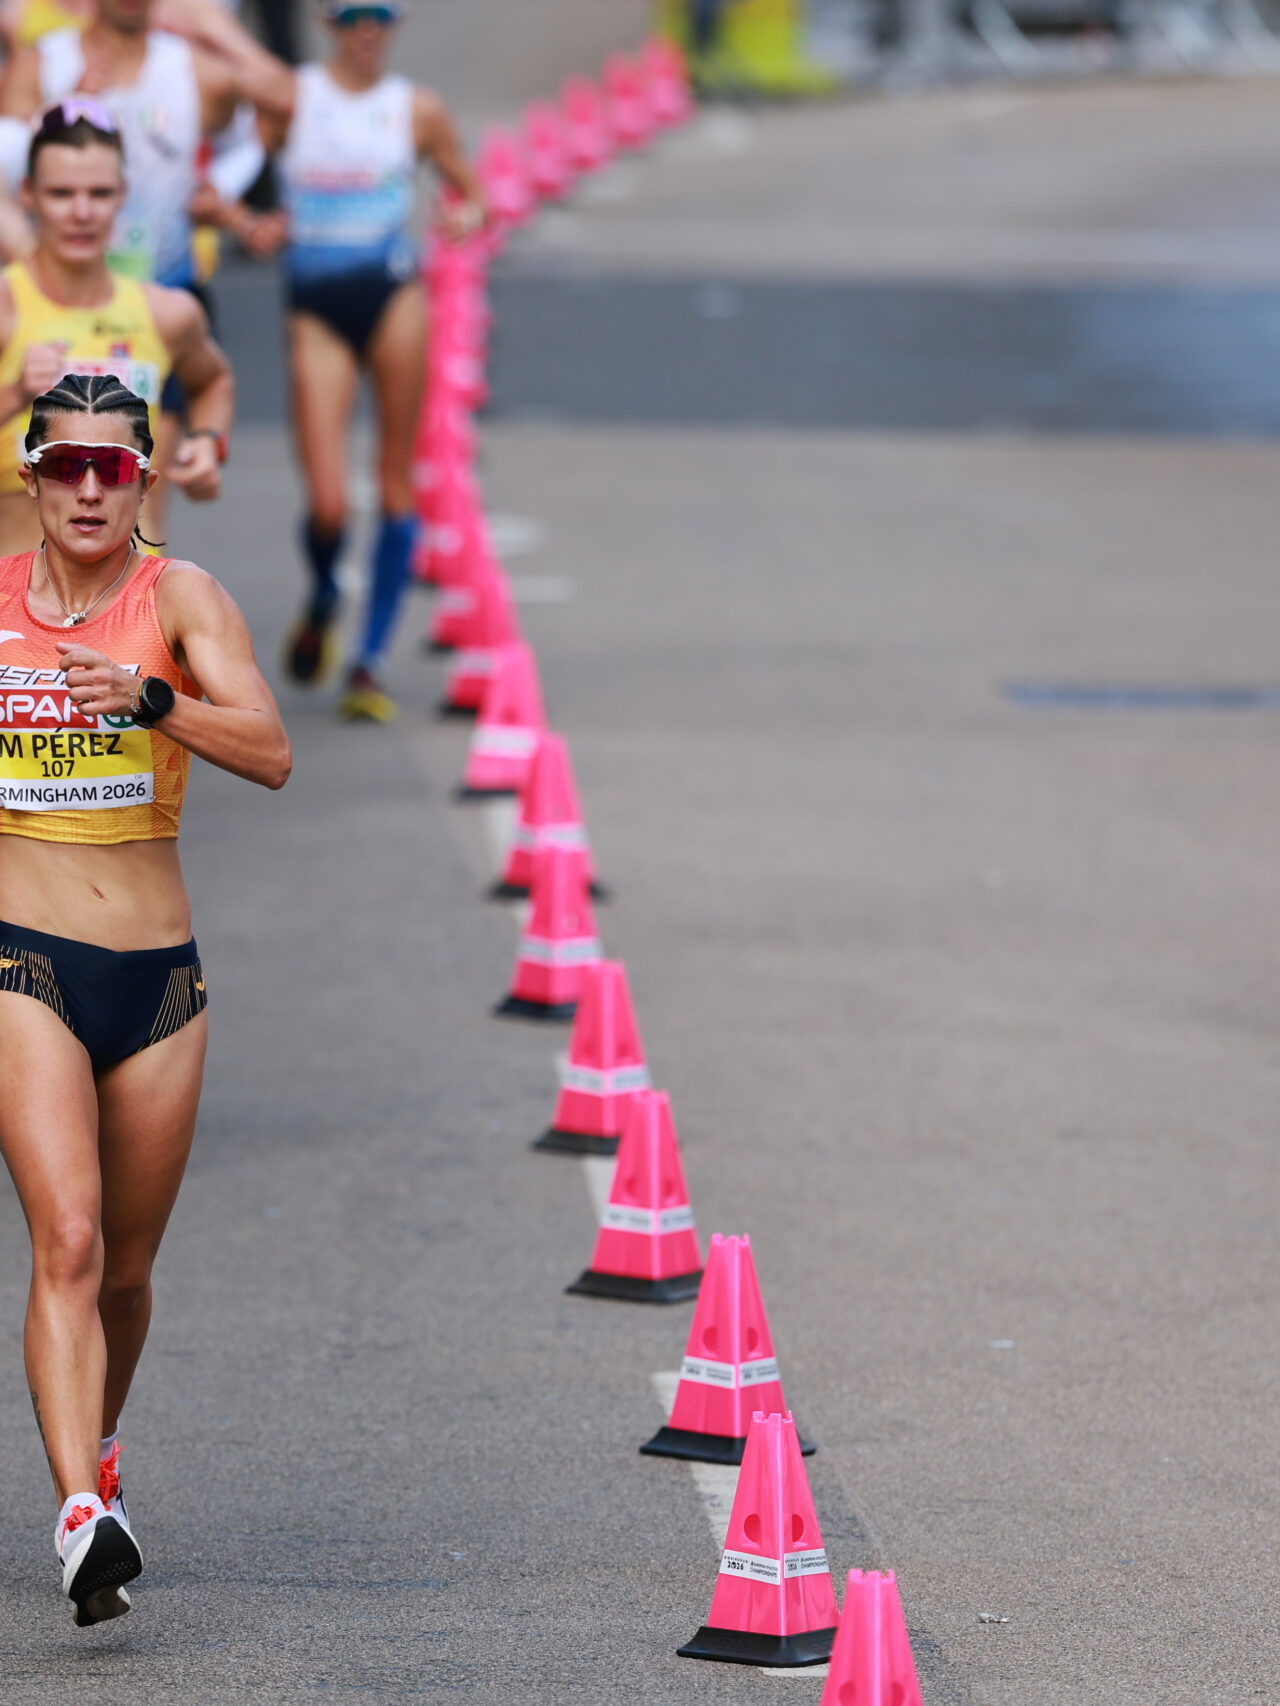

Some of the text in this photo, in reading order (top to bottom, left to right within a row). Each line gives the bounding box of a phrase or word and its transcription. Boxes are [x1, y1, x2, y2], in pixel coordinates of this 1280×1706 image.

[31, 727, 123, 759] PÉREZ
[41, 760, 75, 777] 107
[102, 782, 146, 800] 2026
